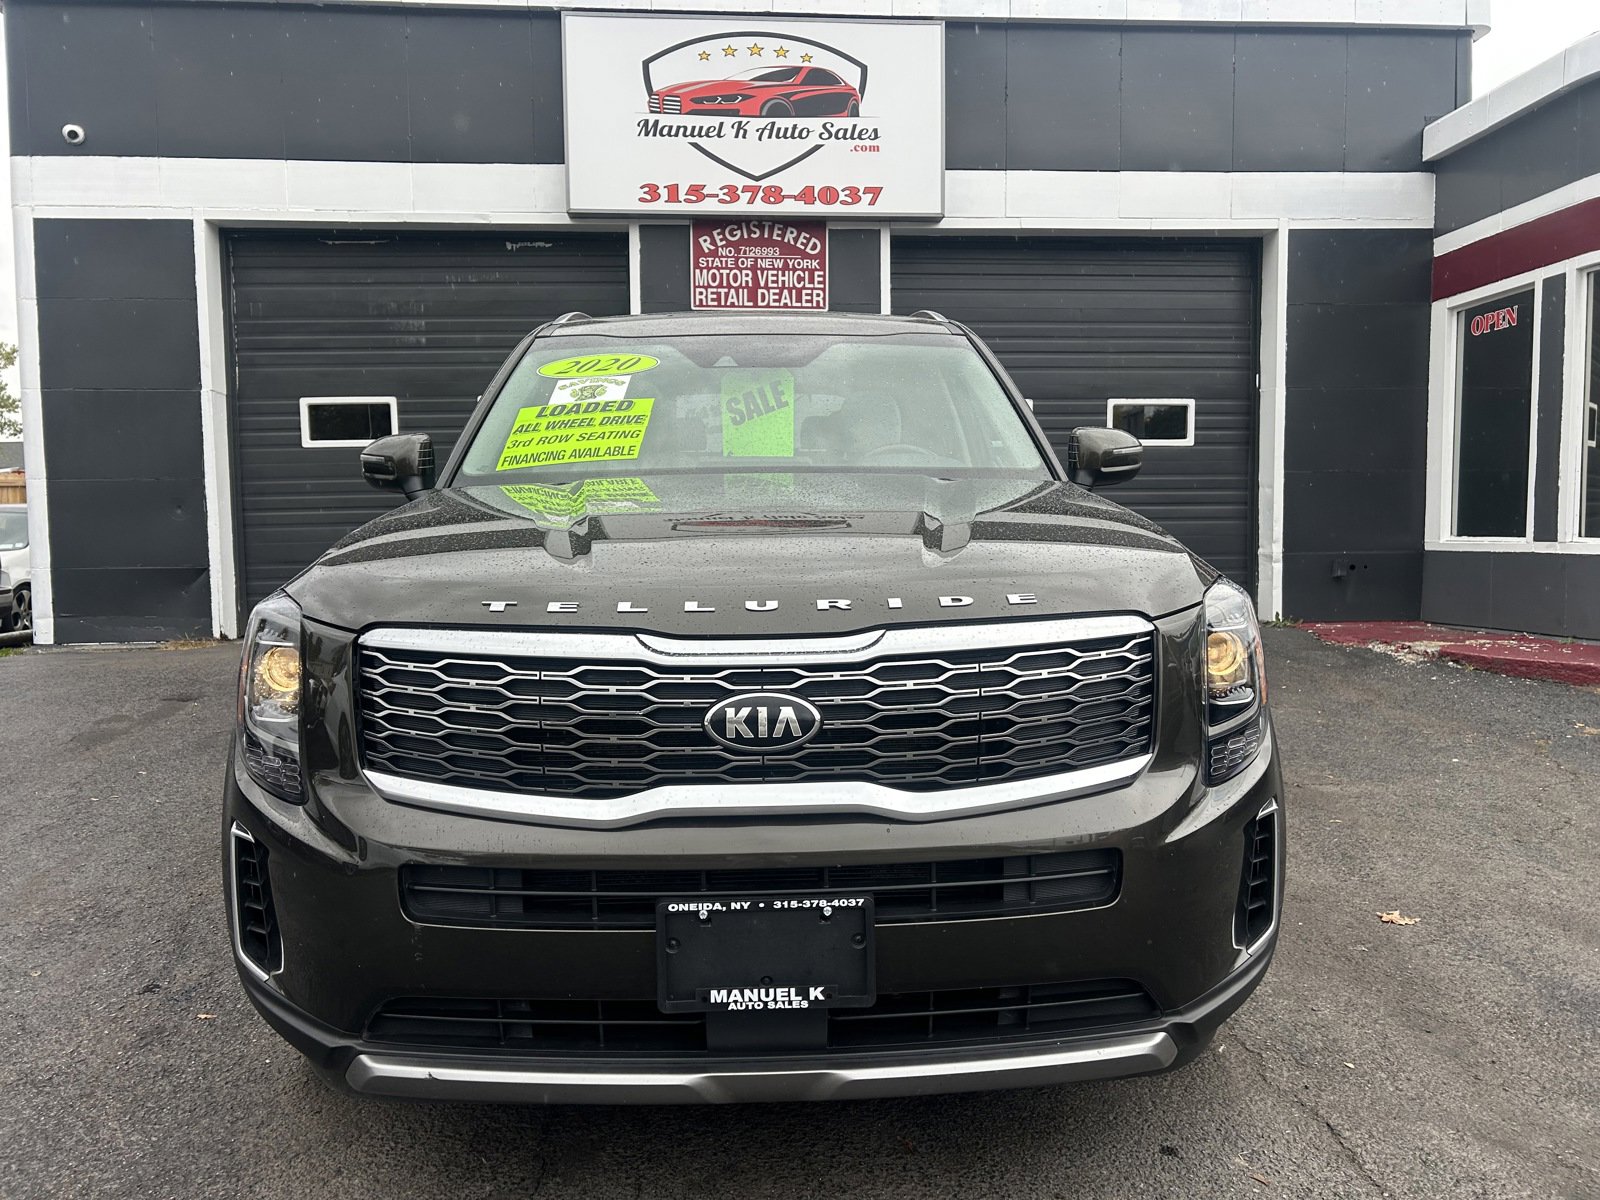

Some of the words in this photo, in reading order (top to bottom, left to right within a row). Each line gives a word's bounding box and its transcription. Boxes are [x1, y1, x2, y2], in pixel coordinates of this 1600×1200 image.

[637, 118, 726, 139] Manuel
[730, 120, 751, 140] K
[755, 121, 815, 141] Auto
[818, 121, 881, 141] Sales
[849, 144, 880, 153] .com
[638, 183, 884, 206] 315-378-4037
[698, 220, 821, 255] REGISTERED
[718, 247, 738, 257] NO.
[739, 246, 780, 256] 7126993
[699, 257, 735, 268] STATE
[738, 258, 754, 268] OF
[757, 259, 784, 269] NEW
[787, 259, 820, 269] YORK
[695, 269, 753, 287] MOTOR
[757, 270, 824, 288] VEHICLE
[695, 288, 753, 306] RETAIL
[757, 288, 824, 307] DEALER
[1470, 305, 1518, 337] OPEN
[555, 356, 642, 375] 2020
[535, 399, 635, 419] LOADED
[725, 380, 790, 427] SALE
[512, 421, 541, 436] ALL
[545, 417, 597, 432] WHEEL
[599, 414, 647, 427] DRIVE
[506, 438, 533, 450] 3rd
[536, 433, 574, 446] ROW
[576, 429, 643, 442] SEATING
[500, 449, 567, 468] FINANCING
[568, 445, 637, 460] AVAILABLE
[482, 593, 1037, 613] TELLURIDE
[724, 706, 803, 739] KIA
[667, 902, 727, 912] ONEIDA,
[730, 902, 751, 910] NY
[772, 898, 865, 909] 315-378-4037
[710, 988, 803, 1004] MANUEL
[808, 986, 826, 1001] K
[727, 1001, 764, 1011] AUTO
[767, 1000, 809, 1010] SALES
